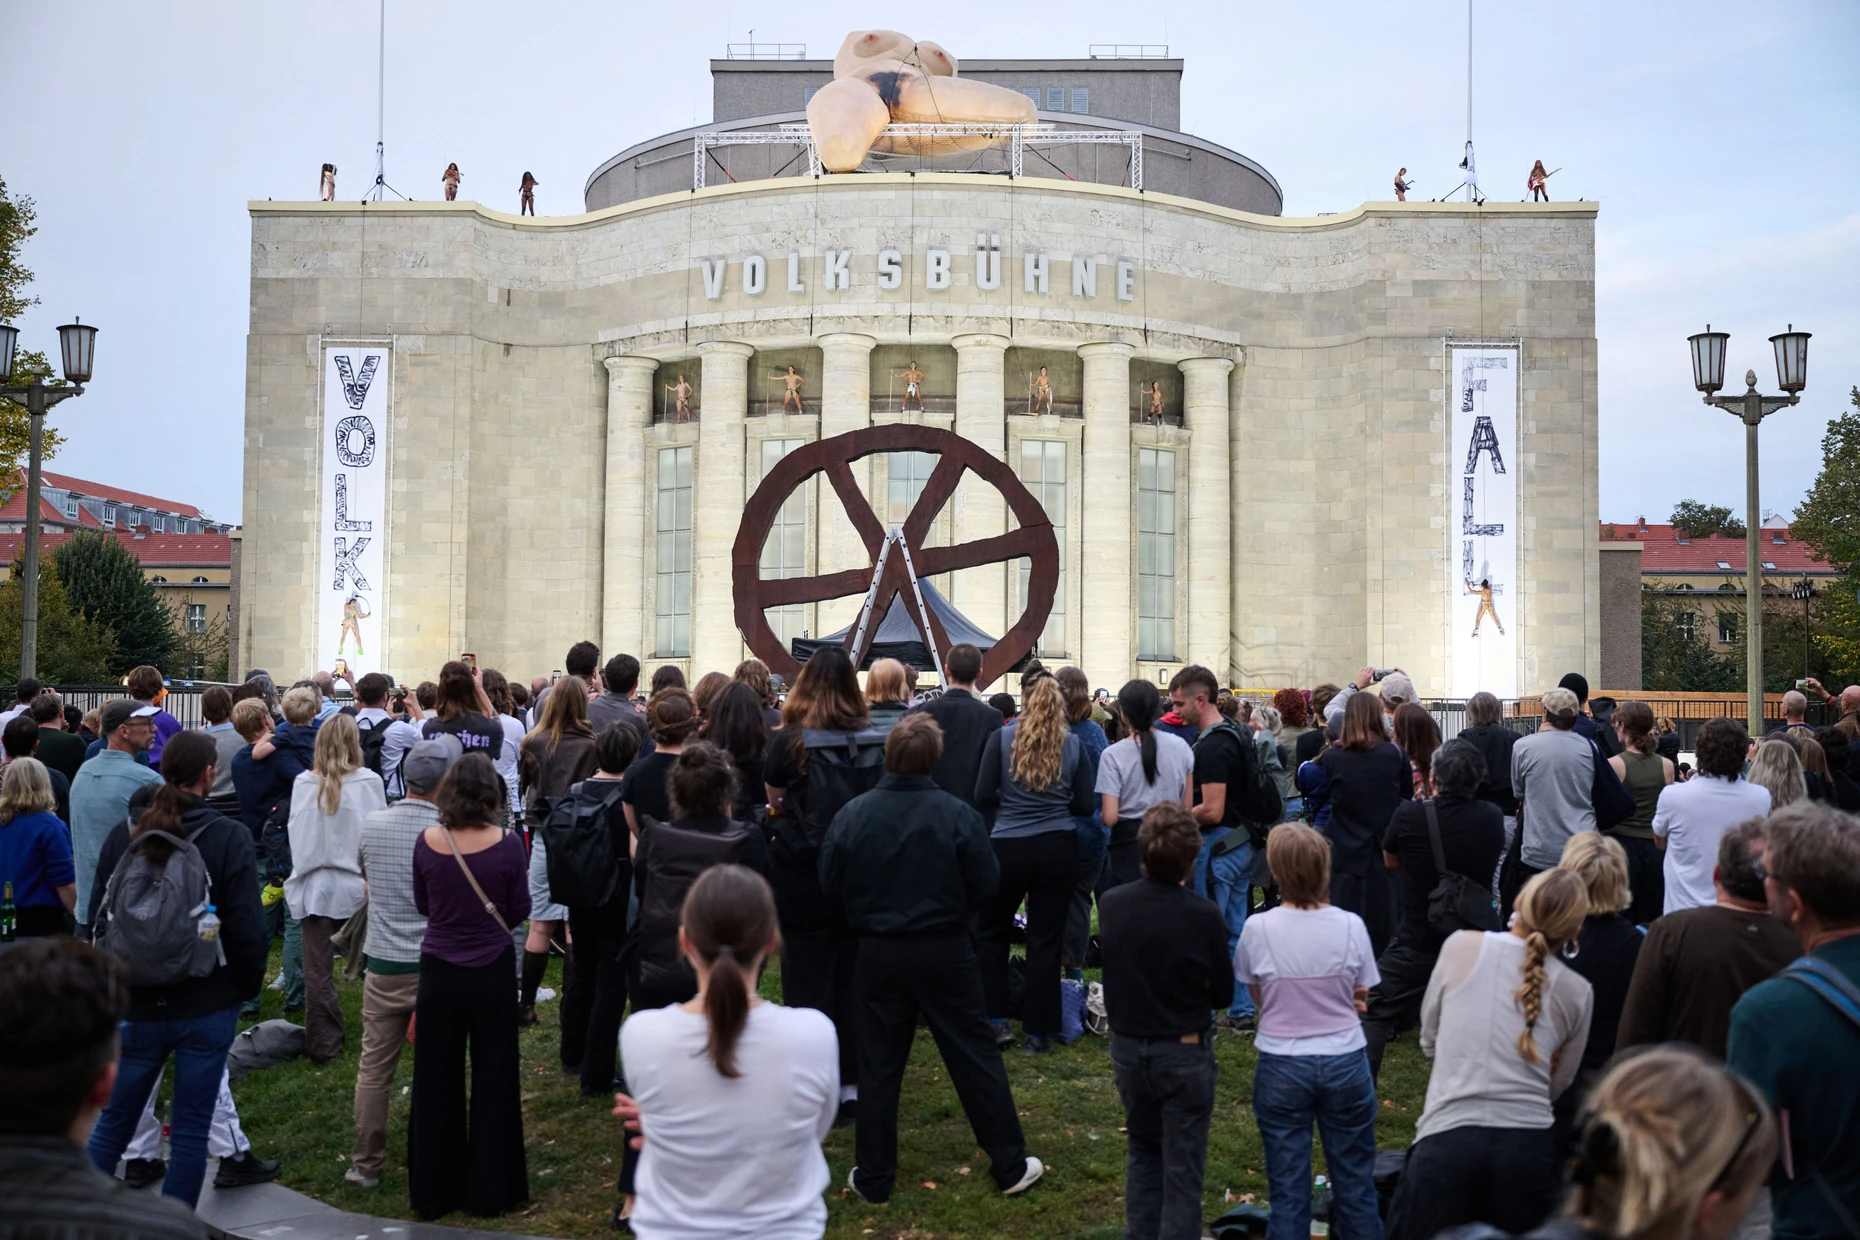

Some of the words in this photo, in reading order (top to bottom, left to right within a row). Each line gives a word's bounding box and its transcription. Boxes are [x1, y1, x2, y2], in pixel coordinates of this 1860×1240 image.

[700, 231, 1135, 303] VOLKSBÜHNE
[333, 354, 381, 591] VOLK
[1460, 356, 1508, 596] FALL
